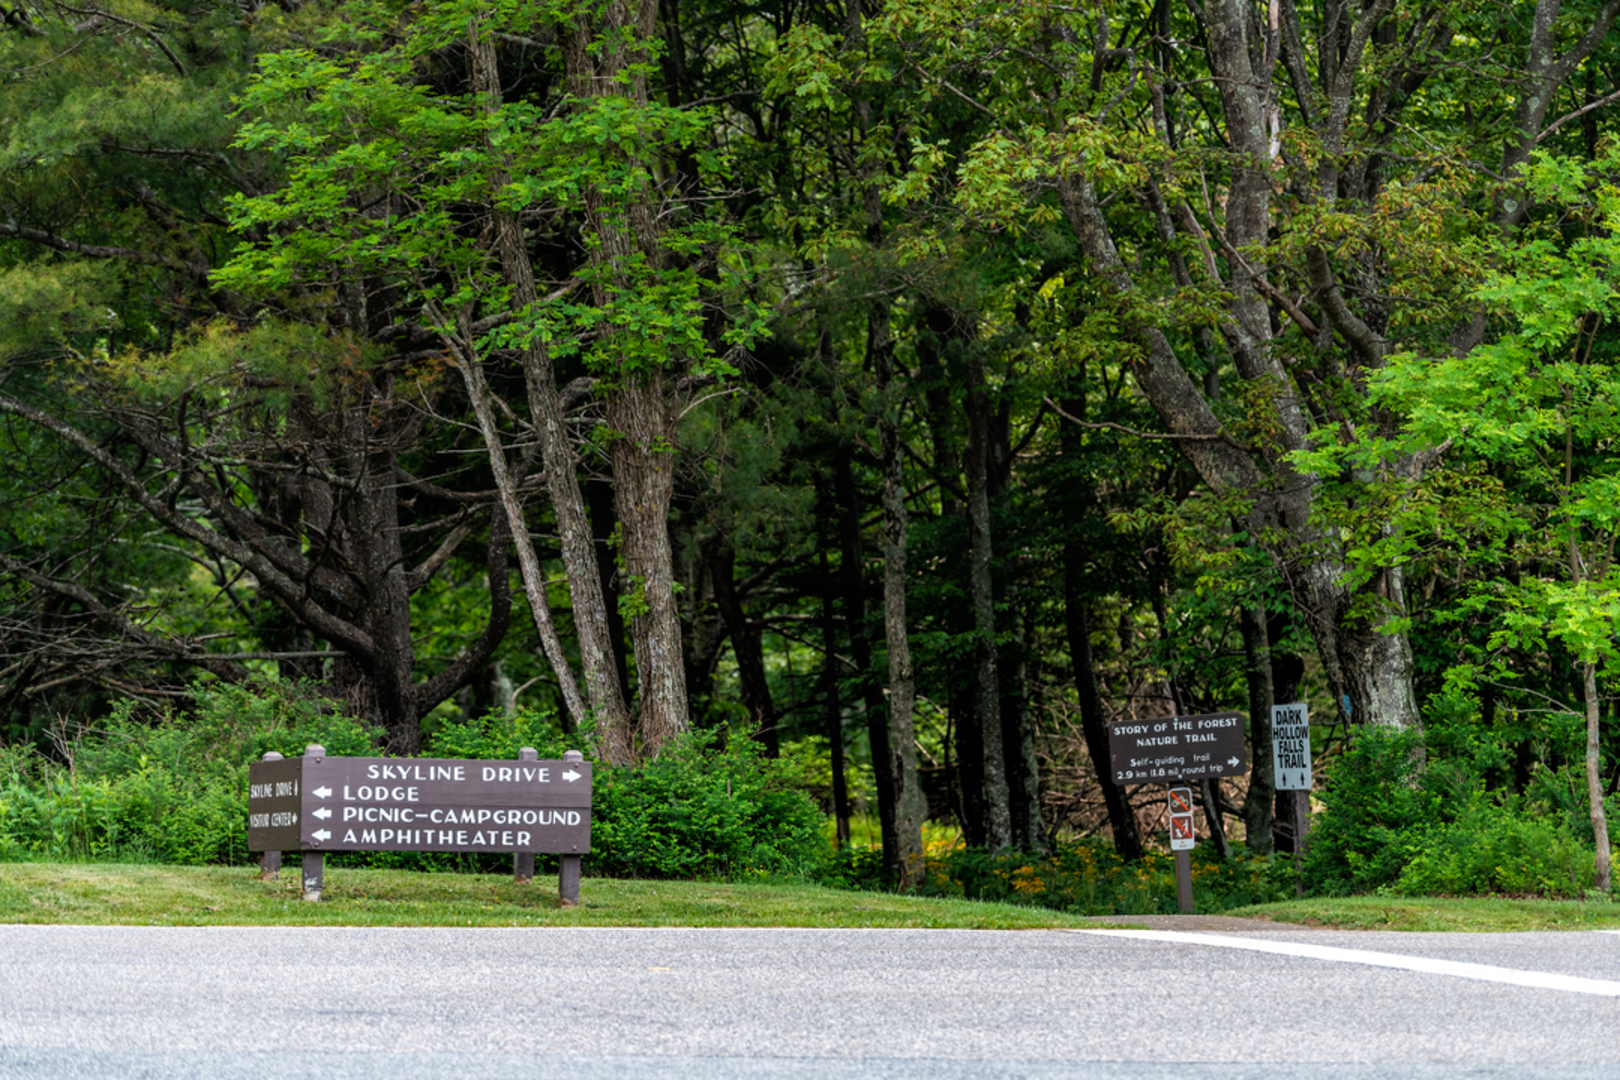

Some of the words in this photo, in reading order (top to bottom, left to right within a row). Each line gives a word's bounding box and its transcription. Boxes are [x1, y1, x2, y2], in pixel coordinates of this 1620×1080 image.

[1276, 710, 1302, 725] DARK
[1114, 725, 1148, 736] STORY
[1154, 723, 1167, 733] OF
[1173, 721, 1193, 731] THE
[1198, 718, 1237, 729] FOREST
[1273, 726, 1308, 740] HOLLOW
[1137, 735, 1178, 747] NATURE
[1185, 733, 1217, 743] TRAIL
[1279, 741, 1304, 753] FALLS
[1130, 755, 1185, 767] Self-guiding
[1194, 754, 1210, 762] trail
[1278, 754, 1306, 768] TRAIL
[367, 764, 466, 781] SKYLINE
[482, 766, 551, 783] DRIVE
[1117, 770, 1133, 779] 2.9
[1182, 765, 1205, 775] round
[1210, 763, 1224, 772] trip
[250, 783, 272, 798] SKYLINE
[276, 781, 292, 797] DRIVE
[344, 785, 419, 802] LODGE
[250, 813, 269, 828] VISITOR
[271, 812, 291, 827] CENTER
[343, 807, 581, 826] PICNIC-CAMPGROUND
[342, 828, 531, 846] AMPHITHEATER
